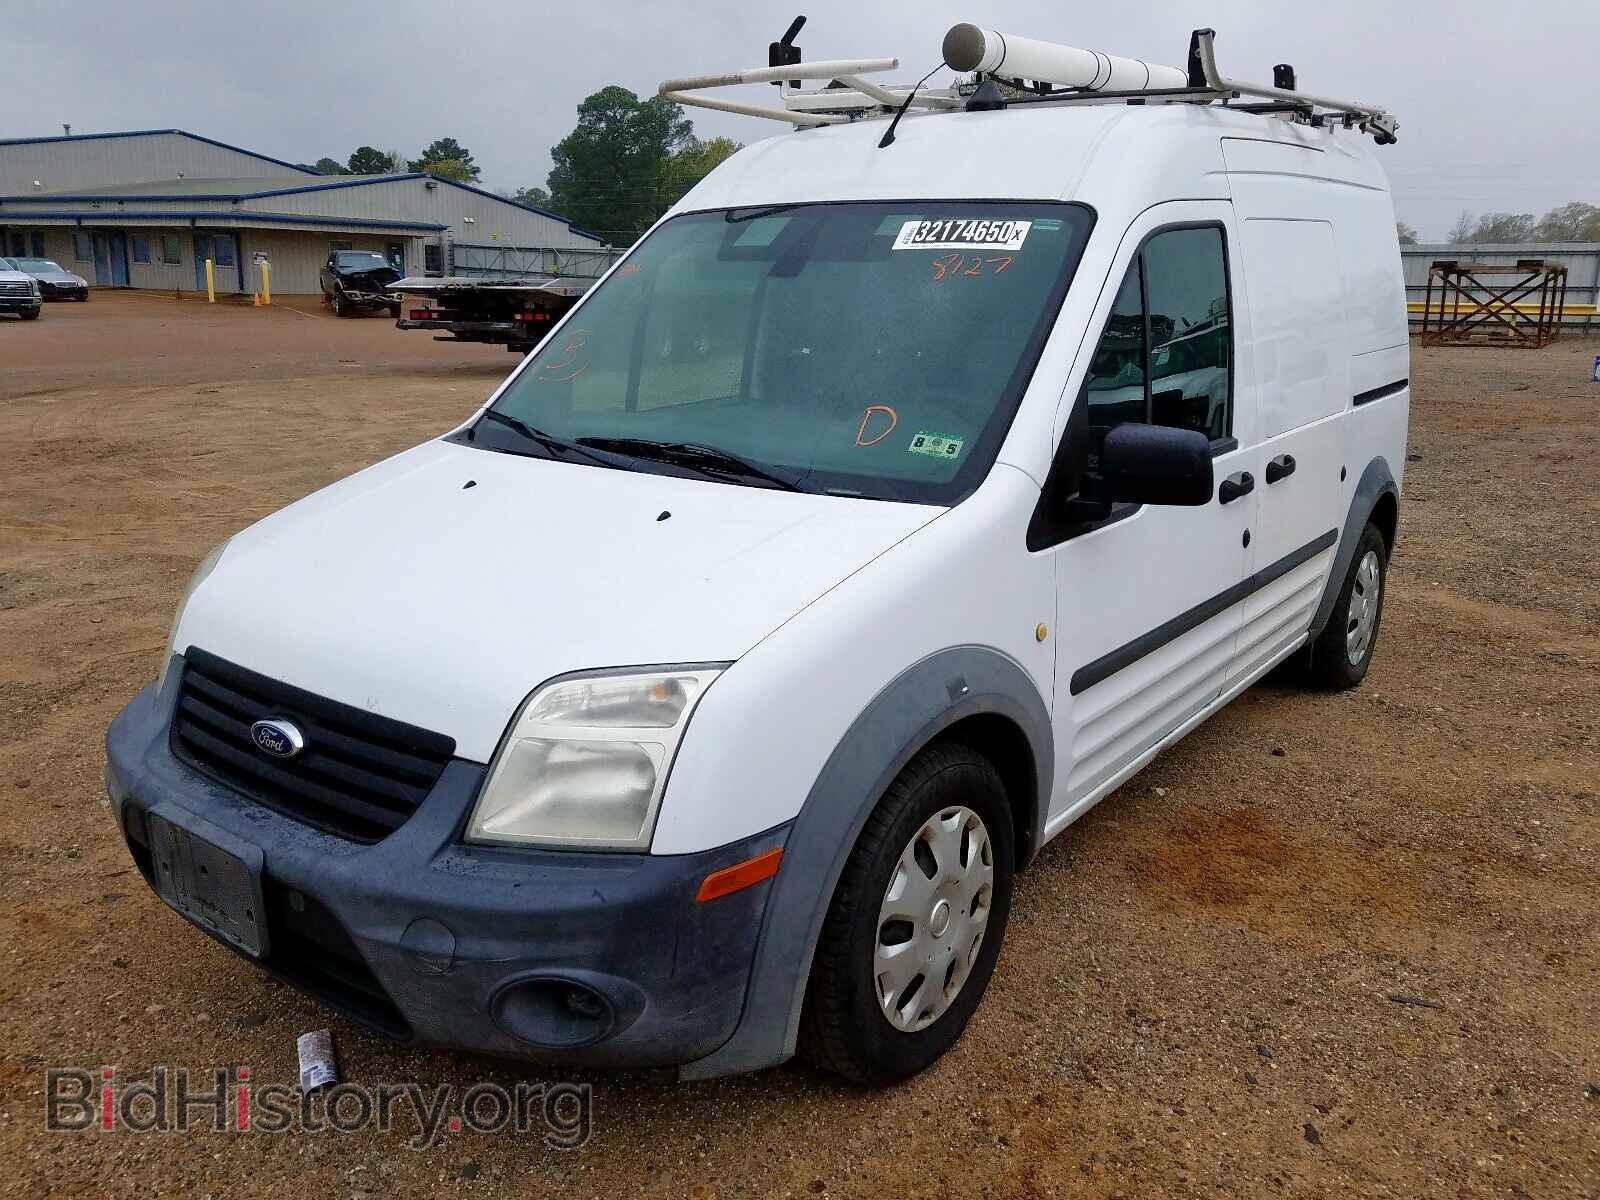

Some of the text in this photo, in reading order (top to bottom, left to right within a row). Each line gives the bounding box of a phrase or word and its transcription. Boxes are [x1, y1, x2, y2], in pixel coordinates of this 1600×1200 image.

[914, 220, 1014, 242] 32174650
[856, 405, 897, 447] D
[914, 436, 958, 455] 8 5
[258, 727, 285, 752] Ford
